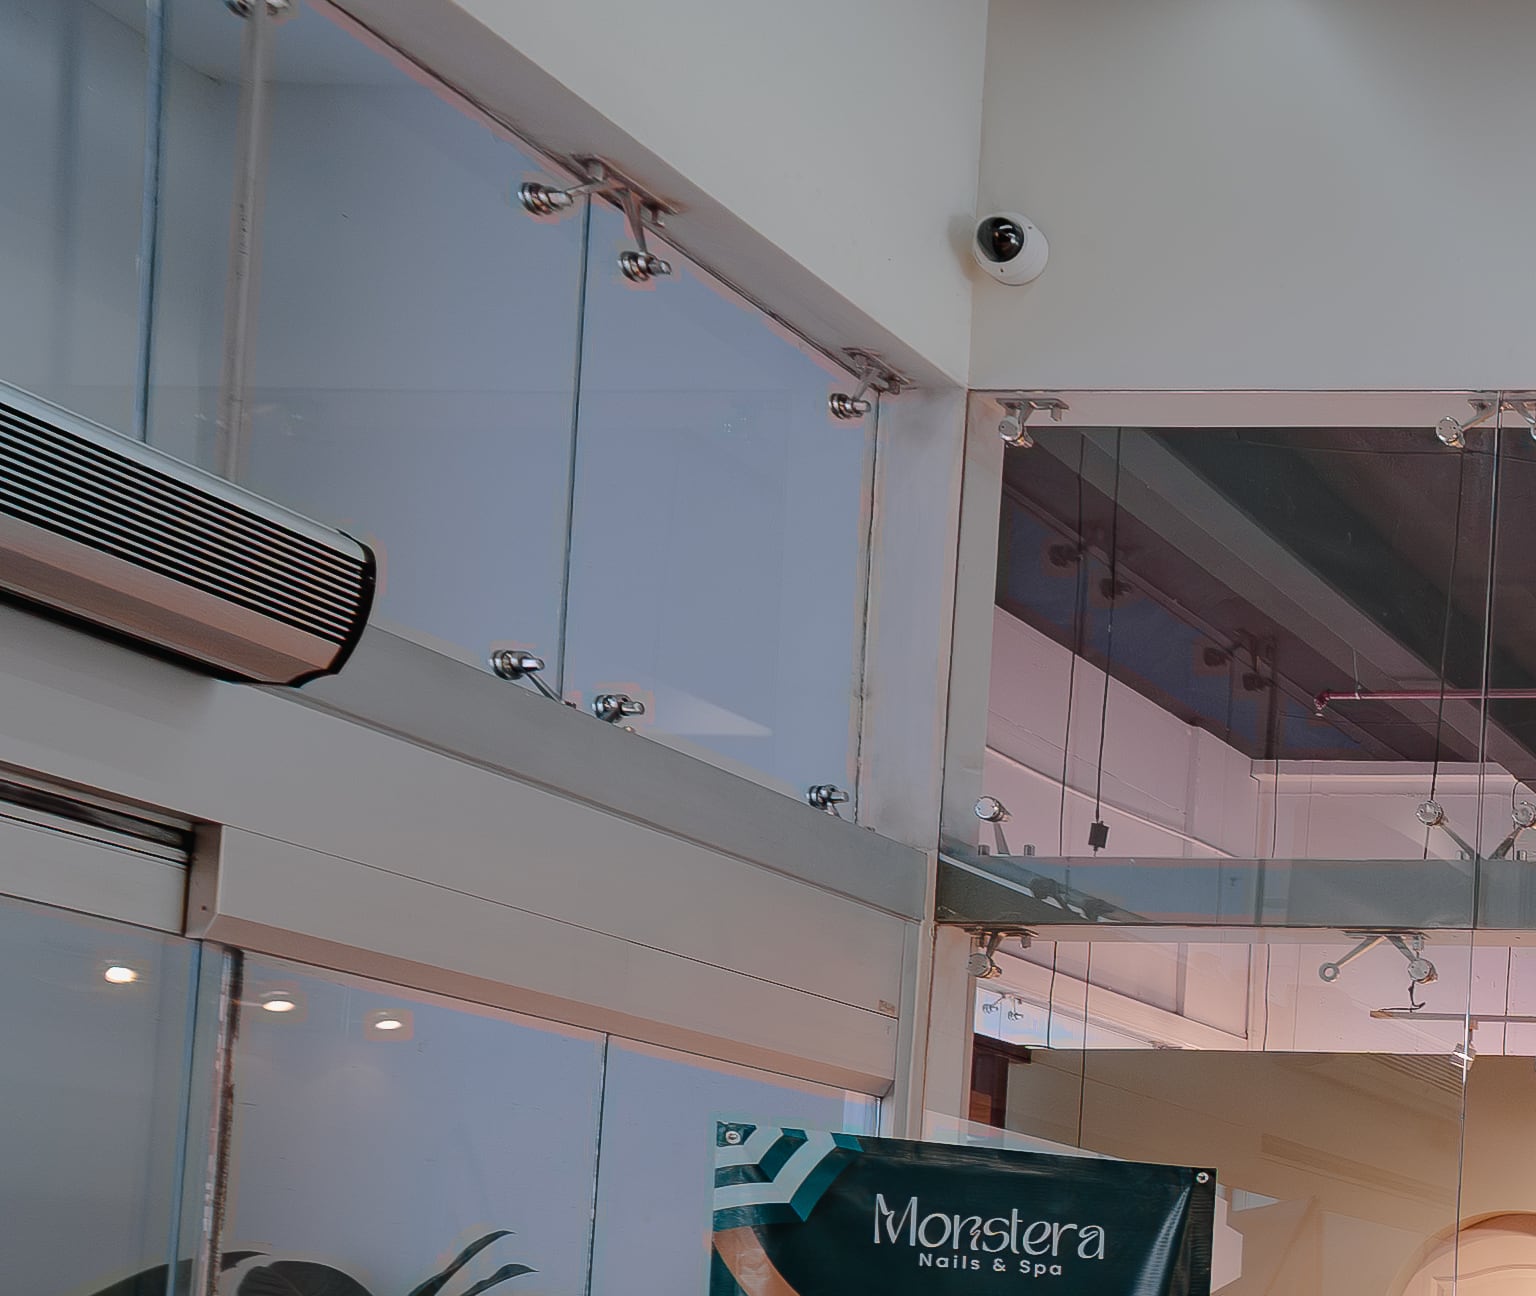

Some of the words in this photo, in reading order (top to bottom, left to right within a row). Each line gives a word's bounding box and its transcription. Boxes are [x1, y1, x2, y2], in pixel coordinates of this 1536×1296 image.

[872, 1193, 1105, 1260] Monstera
[918, 1252, 981, 1271] Nails
[992, 1257, 1007, 1273] &
[1018, 1259, 1063, 1278] Spa
